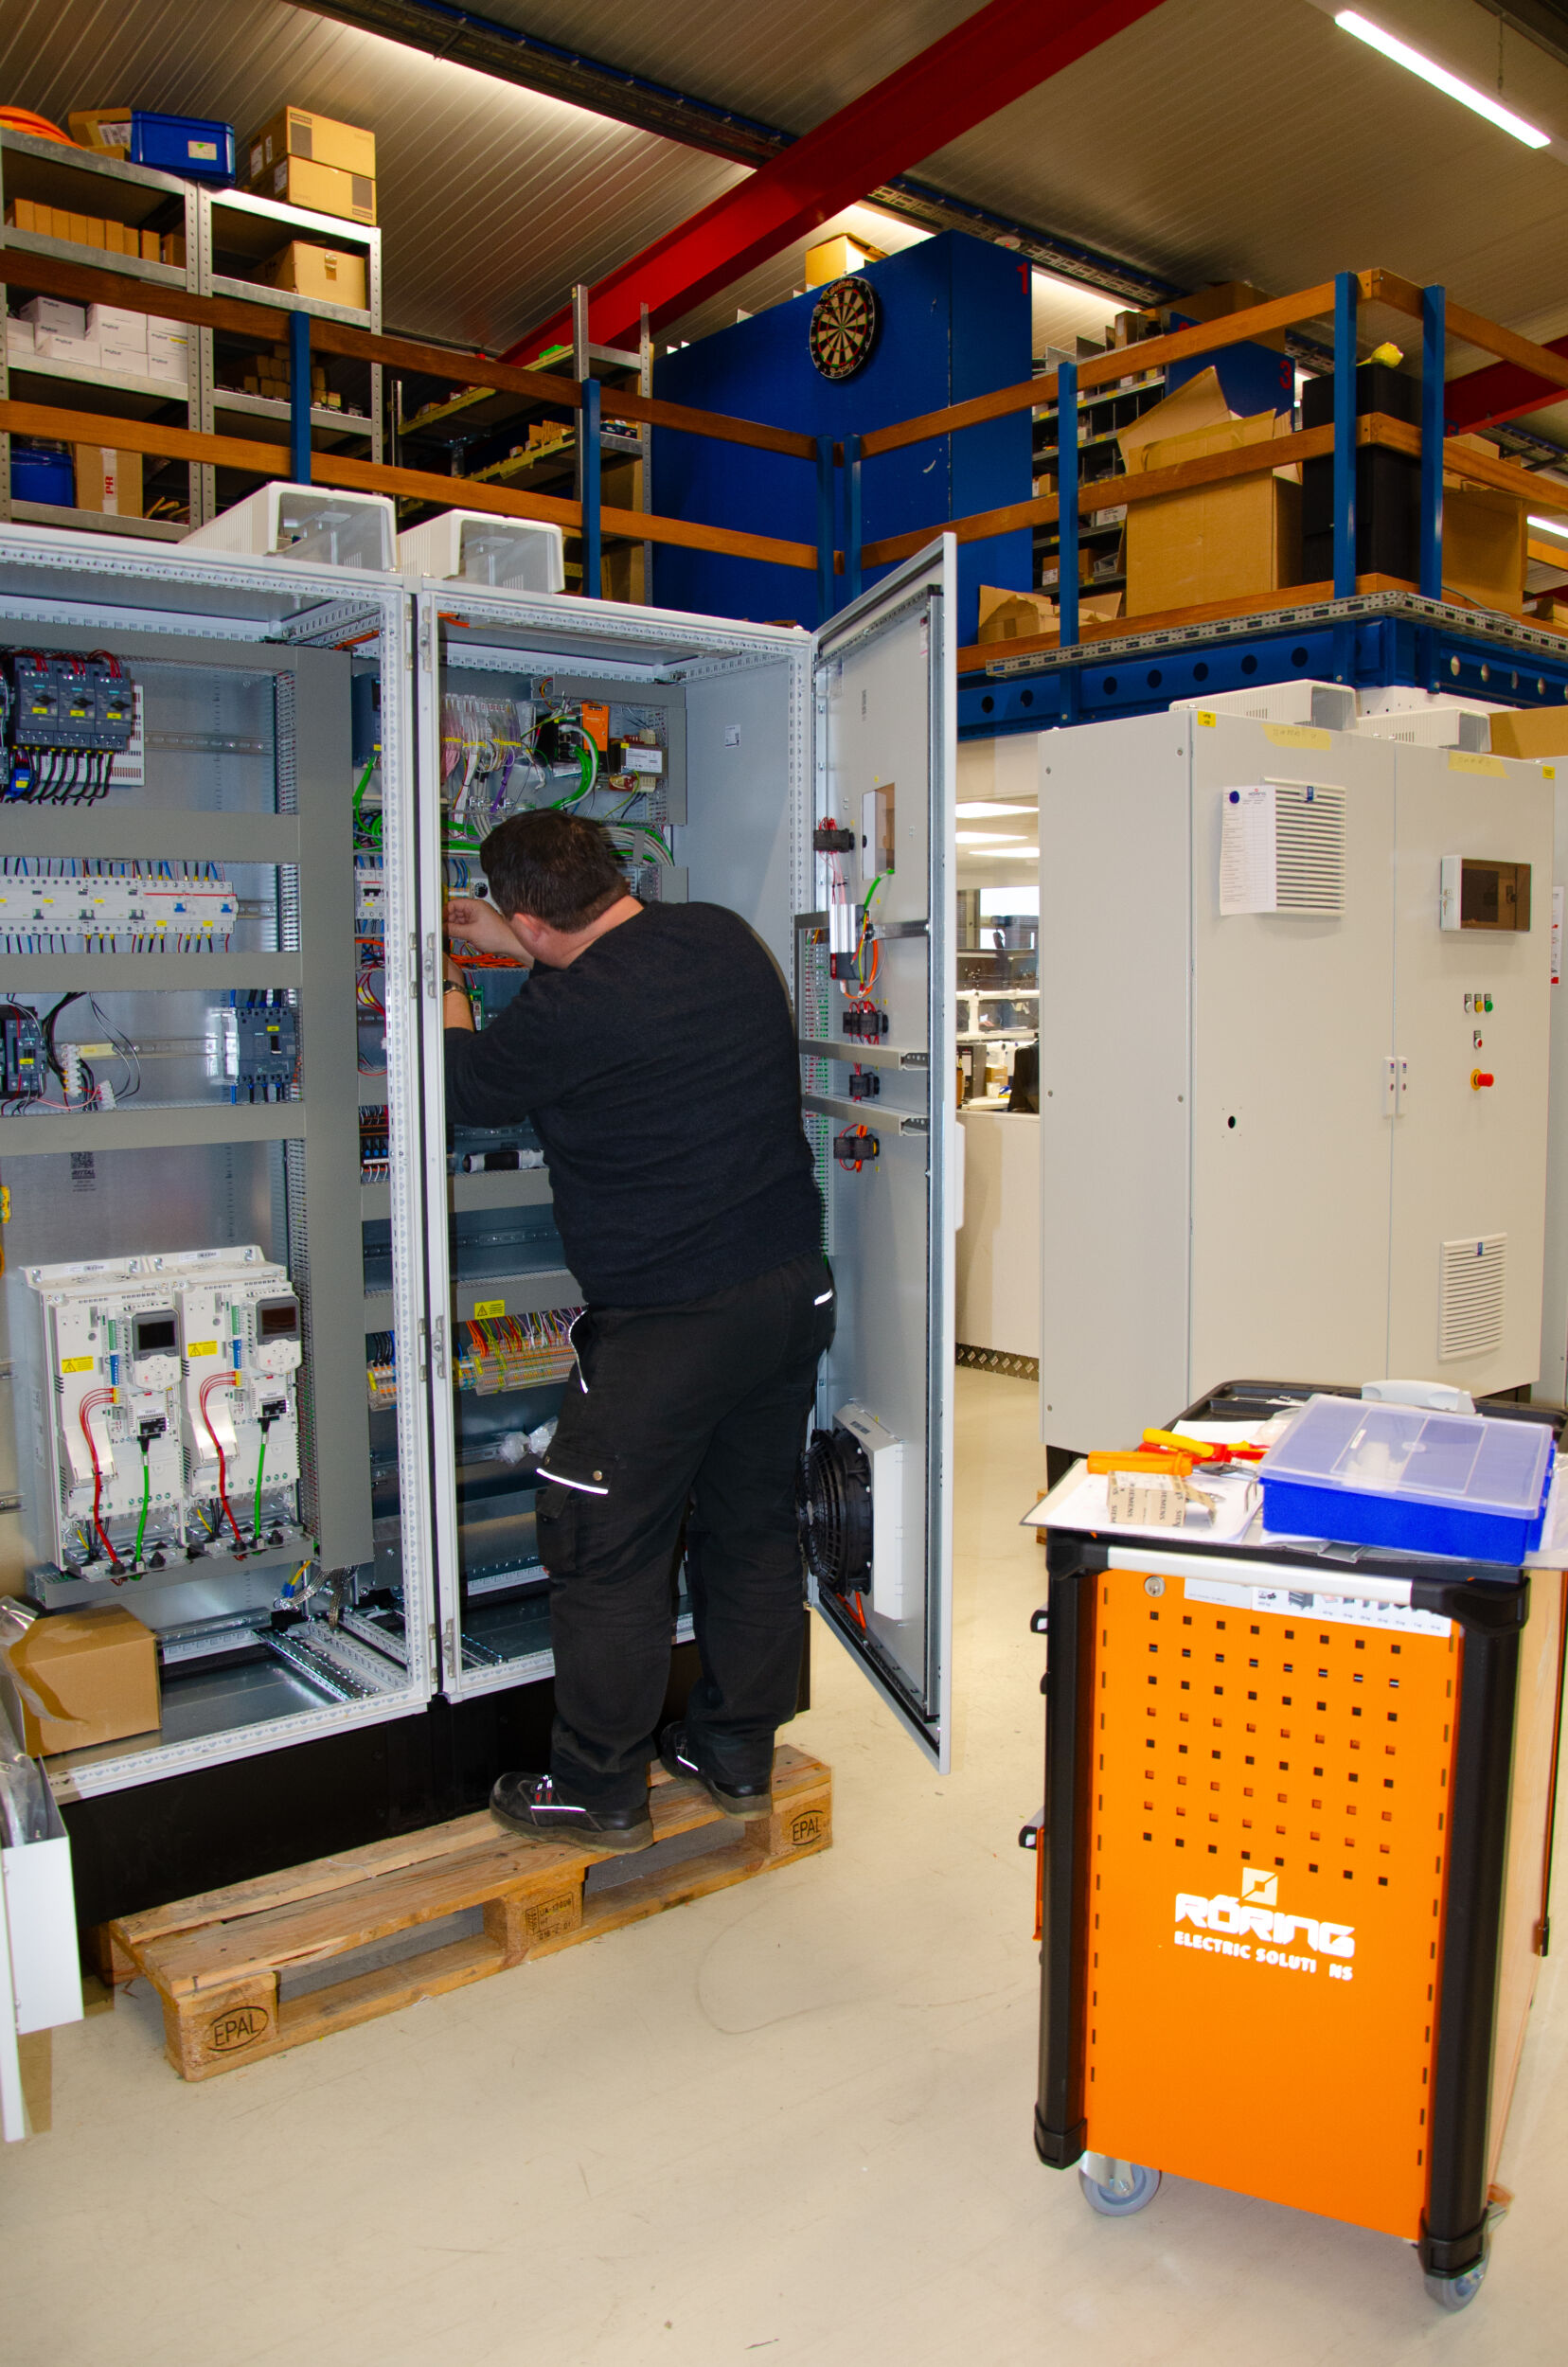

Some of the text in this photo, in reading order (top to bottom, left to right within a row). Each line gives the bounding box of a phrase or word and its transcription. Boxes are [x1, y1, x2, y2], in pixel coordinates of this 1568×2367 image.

[1016, 262, 1028, 295] 1
[1279, 360, 1292, 390] 3
[793, 1817, 822, 1842] EPAL
[1174, 1931, 1354, 1982] ELECTRIC SOLUTINS
[214, 2013, 261, 2047] EPAL
